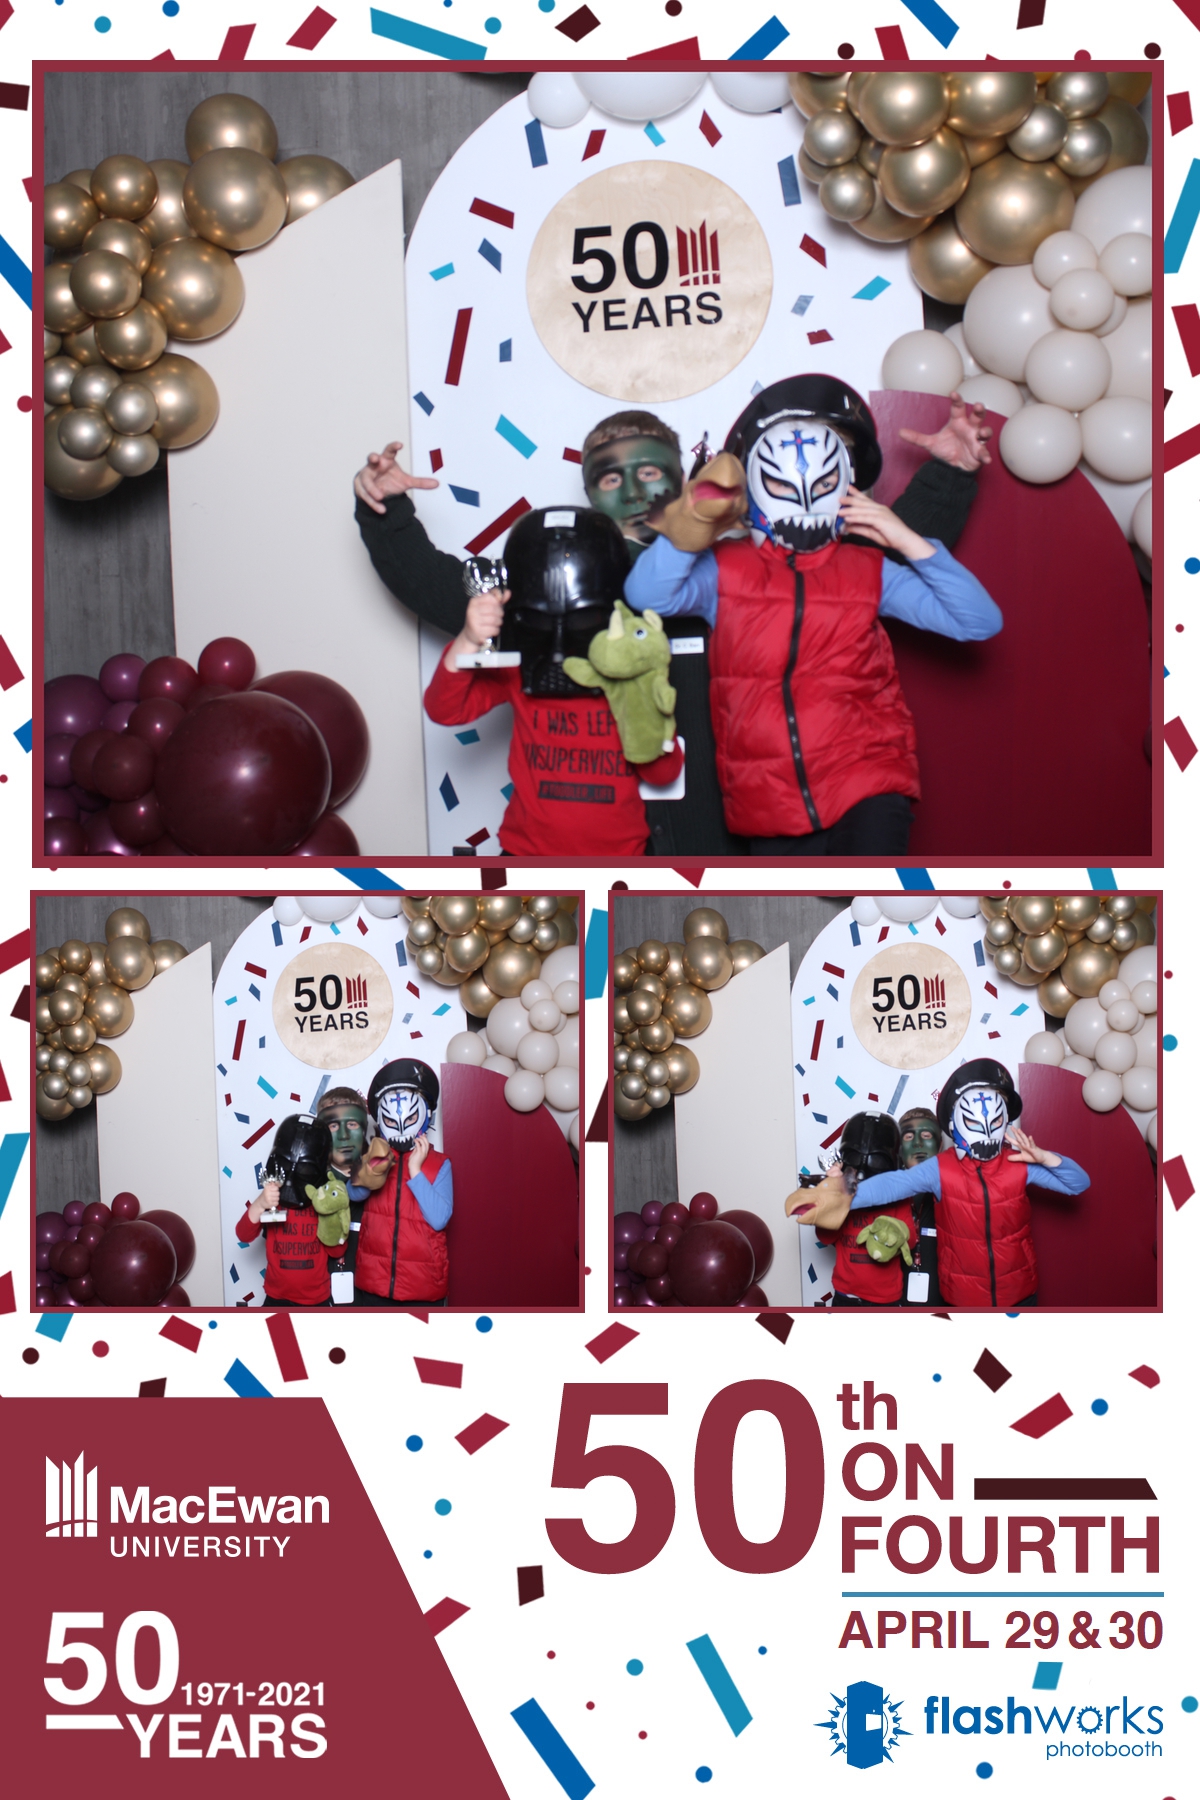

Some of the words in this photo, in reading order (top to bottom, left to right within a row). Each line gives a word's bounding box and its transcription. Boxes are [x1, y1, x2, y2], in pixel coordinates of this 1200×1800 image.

[571, 221, 669, 294] 50
[571, 291, 723, 333] YEARS
[547, 710, 579, 737] WAS
[586, 710, 616, 737] LEF
[294, 974, 343, 1012] 50
[872, 974, 921, 1012] 50
[294, 1011, 369, 1033] YEARS
[872, 1011, 947, 1033] YEARS
[301, 1223, 318, 1237] LEF
